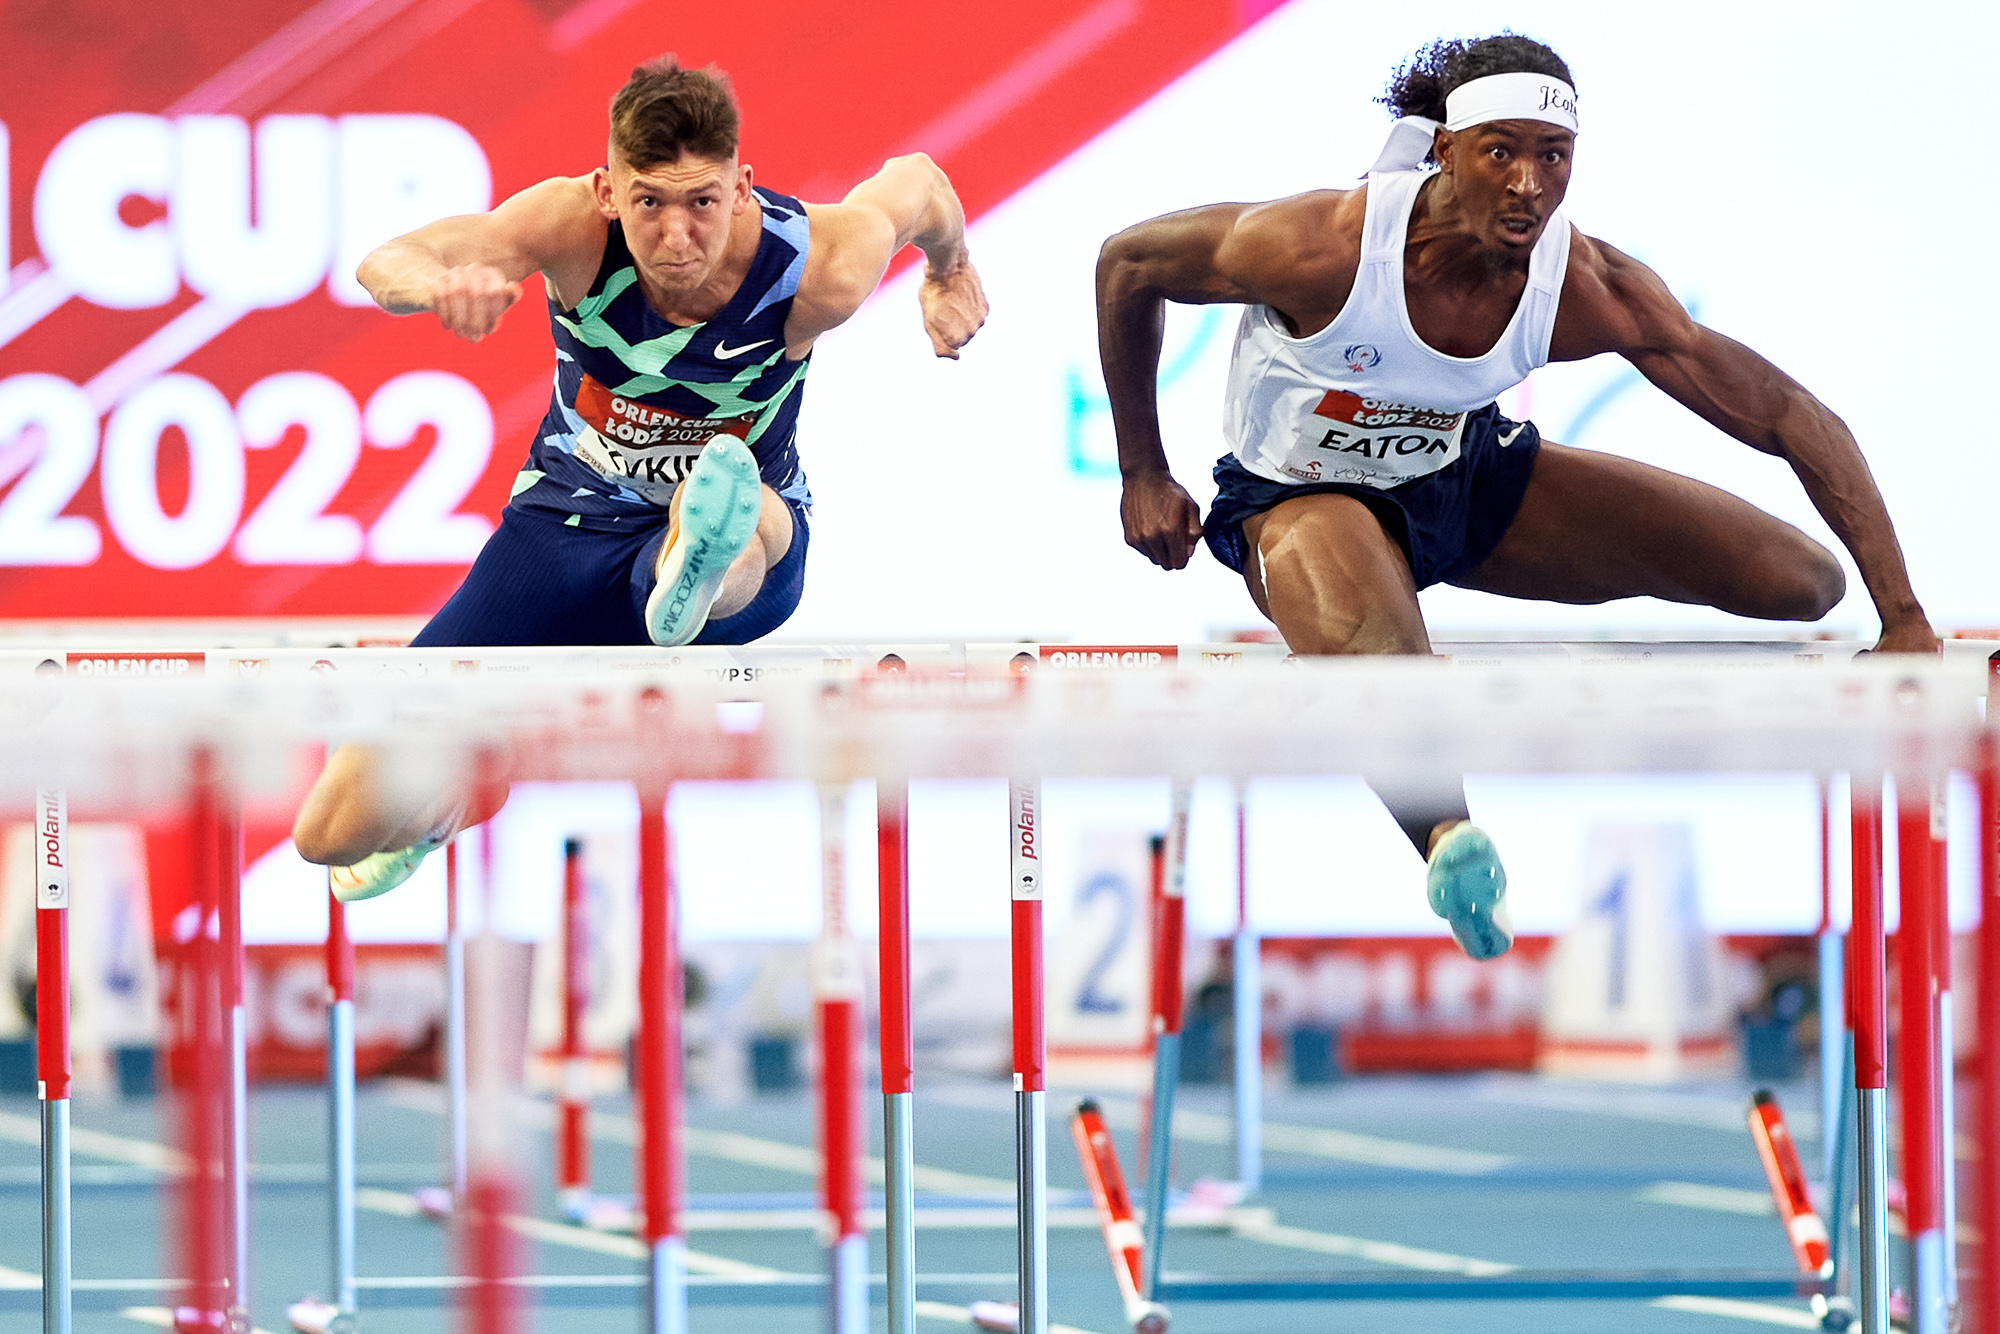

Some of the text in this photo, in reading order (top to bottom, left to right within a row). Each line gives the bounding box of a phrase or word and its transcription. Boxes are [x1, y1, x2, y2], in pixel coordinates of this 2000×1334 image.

[33, 112, 492, 308] CUP
[611, 397, 723, 428] ORLEN CUP
[1352, 410, 1457, 428] ŁÓDŹ 202
[605, 417, 716, 445] ŁÓDŹ 2022
[1318, 429, 1450, 459] EATON
[0, 370, 495, 570] 2022
[662, 569, 698, 634] ZOOM
[77, 658, 190, 676] ORLEN CUP
[1050, 651, 1162, 669] ORLEN CUP
